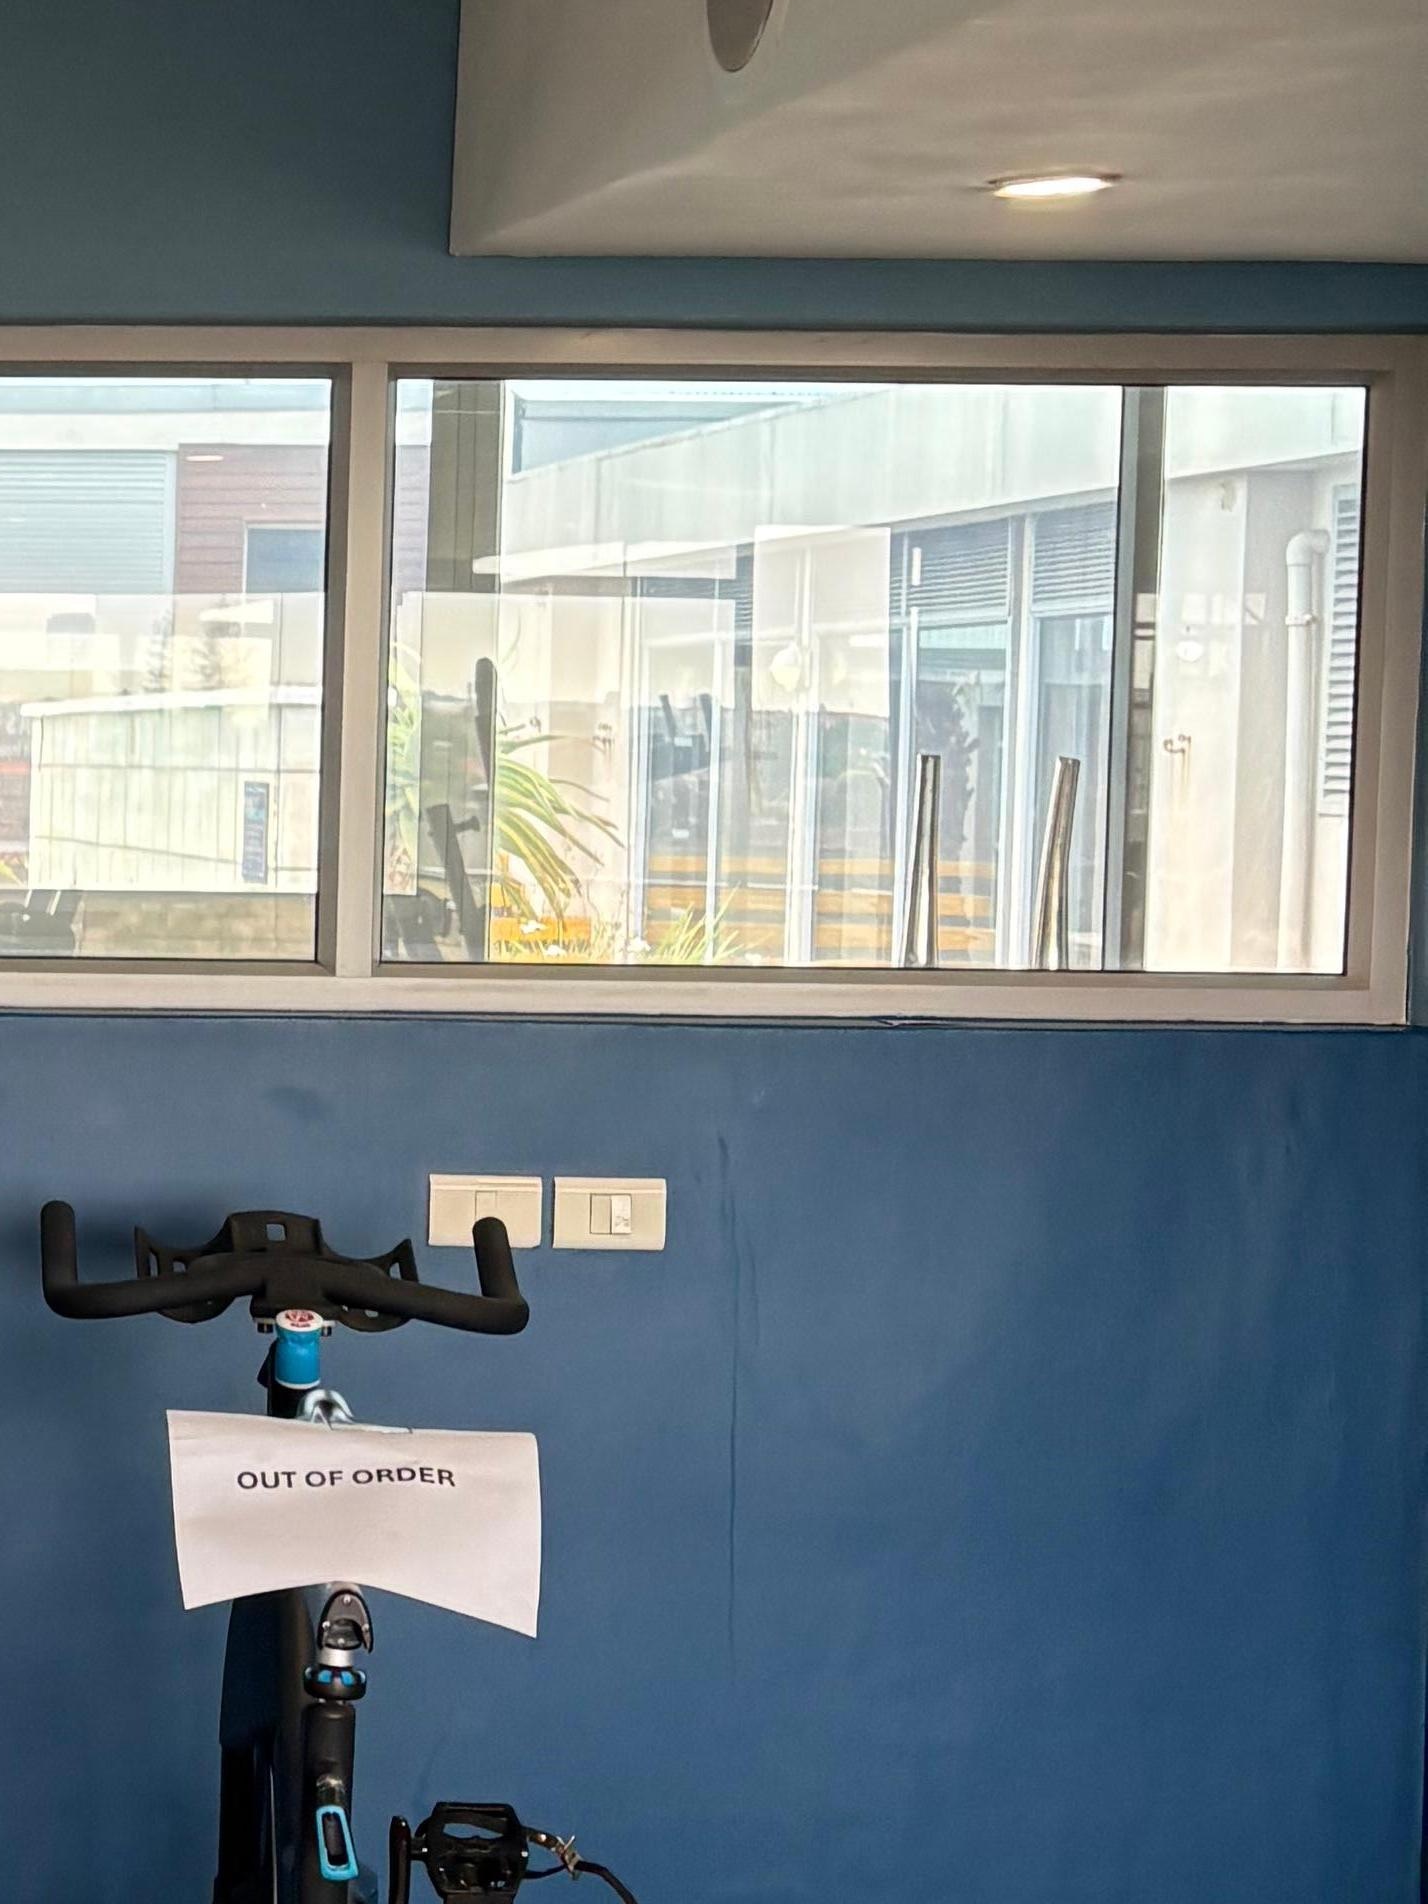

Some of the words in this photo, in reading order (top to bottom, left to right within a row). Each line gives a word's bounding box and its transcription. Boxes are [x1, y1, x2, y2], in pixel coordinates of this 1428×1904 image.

[236, 1470, 297, 1490] OUT
[304, 1470, 344, 1488] OF
[351, 1466, 457, 1488] ORDER
